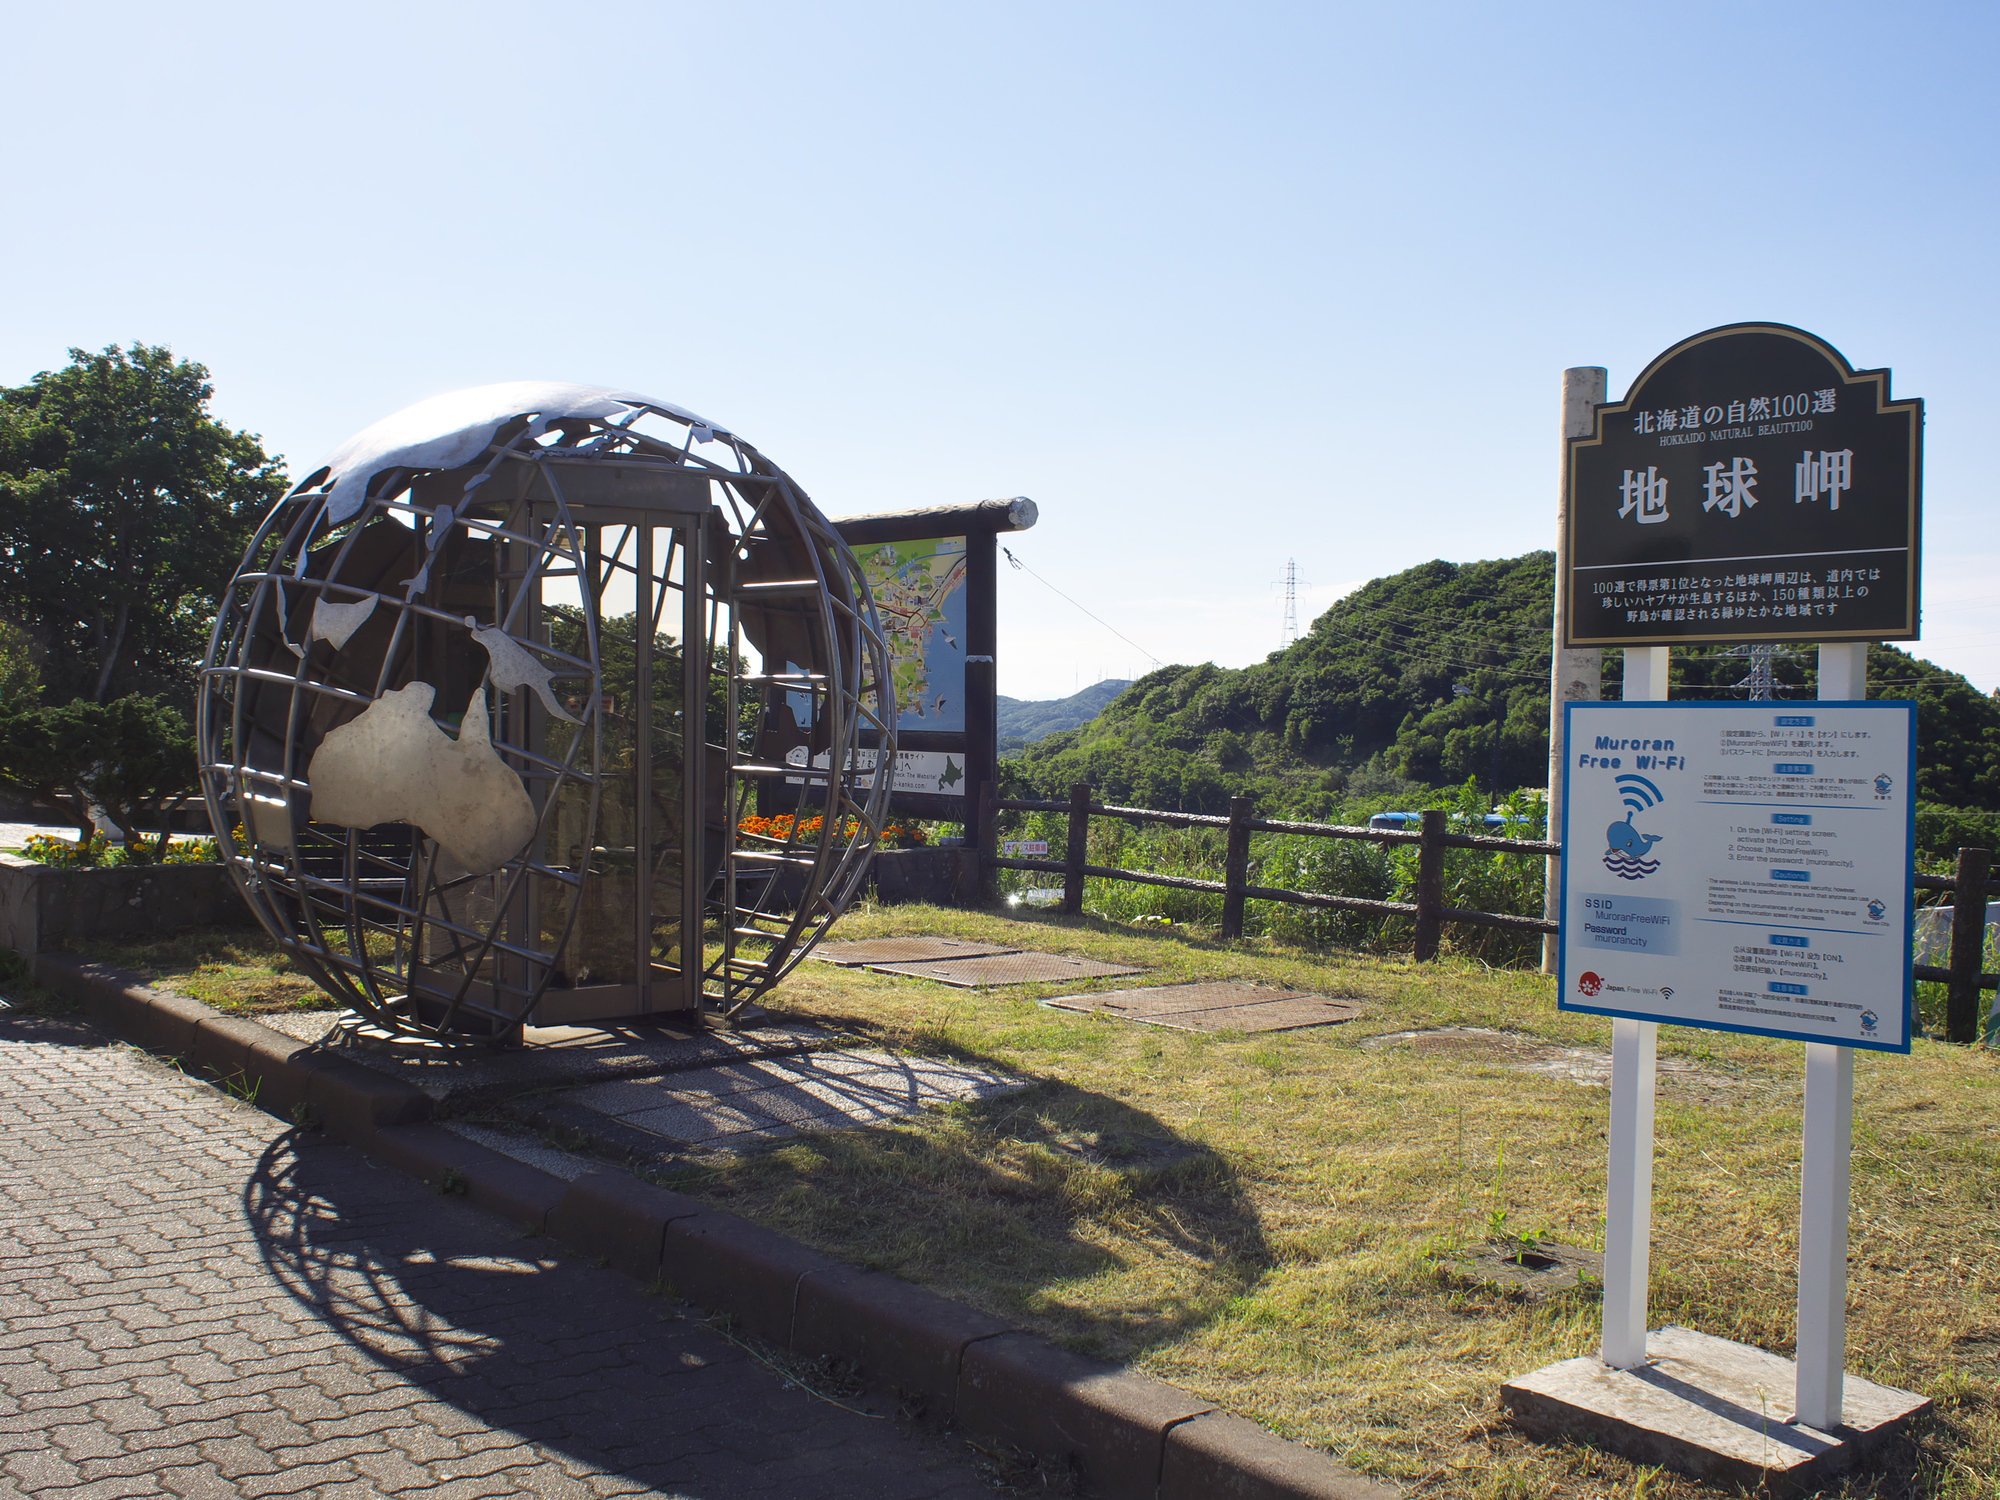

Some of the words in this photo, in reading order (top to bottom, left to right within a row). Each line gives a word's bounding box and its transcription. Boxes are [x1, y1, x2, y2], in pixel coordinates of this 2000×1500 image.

[1633, 388, 1837, 435] 北海道の自然100選
[1659, 431, 1706, 447] HOKKAIDO
[1709, 426, 1754, 442] NATURAL
[1758, 419, 1814, 436] BEAUTY100
[1617, 448, 1854, 524] 地球岬
[1594, 735, 1675, 751] Muroran
[1578, 754, 1621, 769] Free
[1636, 755, 1686, 770] Wi-Fi
[1778, 815, 1804, 824] Setting
[1737, 826, 1747, 834] On
[1784, 829, 1810, 838] setting
[1737, 836, 1764, 844] activate
[1736, 854, 1755, 862] Enter
[1756, 855, 1768, 863] the
[1774, 871, 1805, 880] Cautions
[1584, 898, 1613, 909] SSID
[1595, 910, 1670, 925] MuroranFreeWiFi
[1584, 922, 1627, 935] Password
[1594, 934, 1648, 947] murorancity
[1626, 986, 1640, 994] Free
